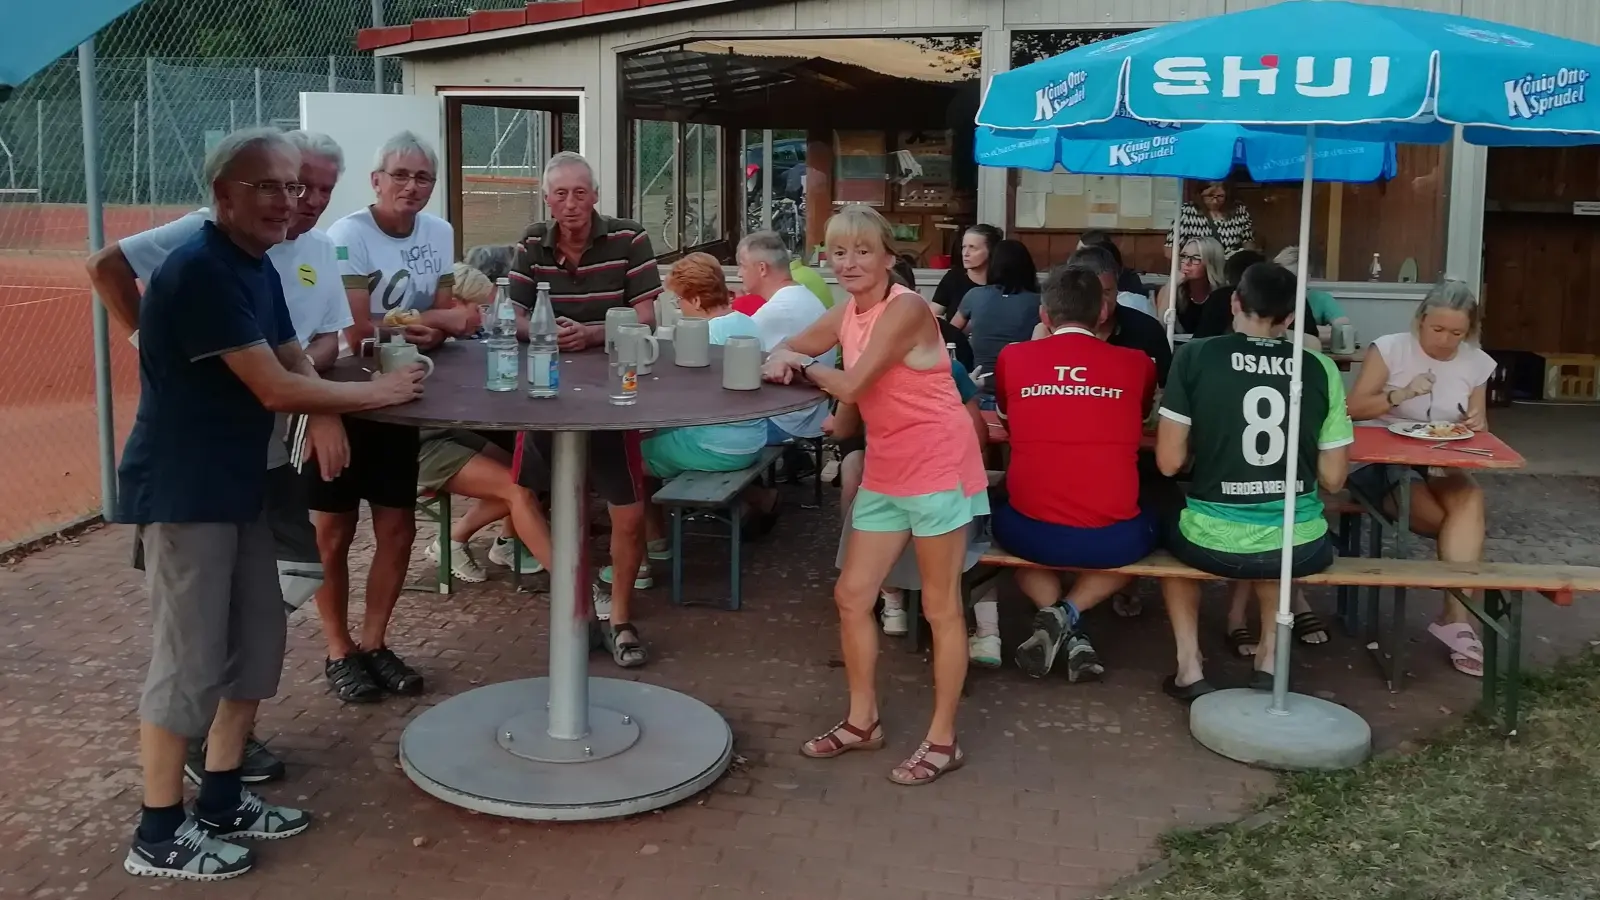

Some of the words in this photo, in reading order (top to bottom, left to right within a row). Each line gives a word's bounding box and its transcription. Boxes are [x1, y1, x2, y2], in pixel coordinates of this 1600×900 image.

[1504, 73, 1556, 119] König
[1529, 85, 1584, 116] Sprudel
[1109, 140, 1151, 167] König
[1130, 145, 1175, 164] Sprudel
[1053, 366, 1087, 382] TC
[1231, 352, 1294, 376] OSAKO
[1021, 383, 1123, 399] DÜRNSRICHT
[1242, 385, 1286, 467] 8
[1221, 481, 1264, 495] WERDER
[1263, 480, 1304, 494] BREN
